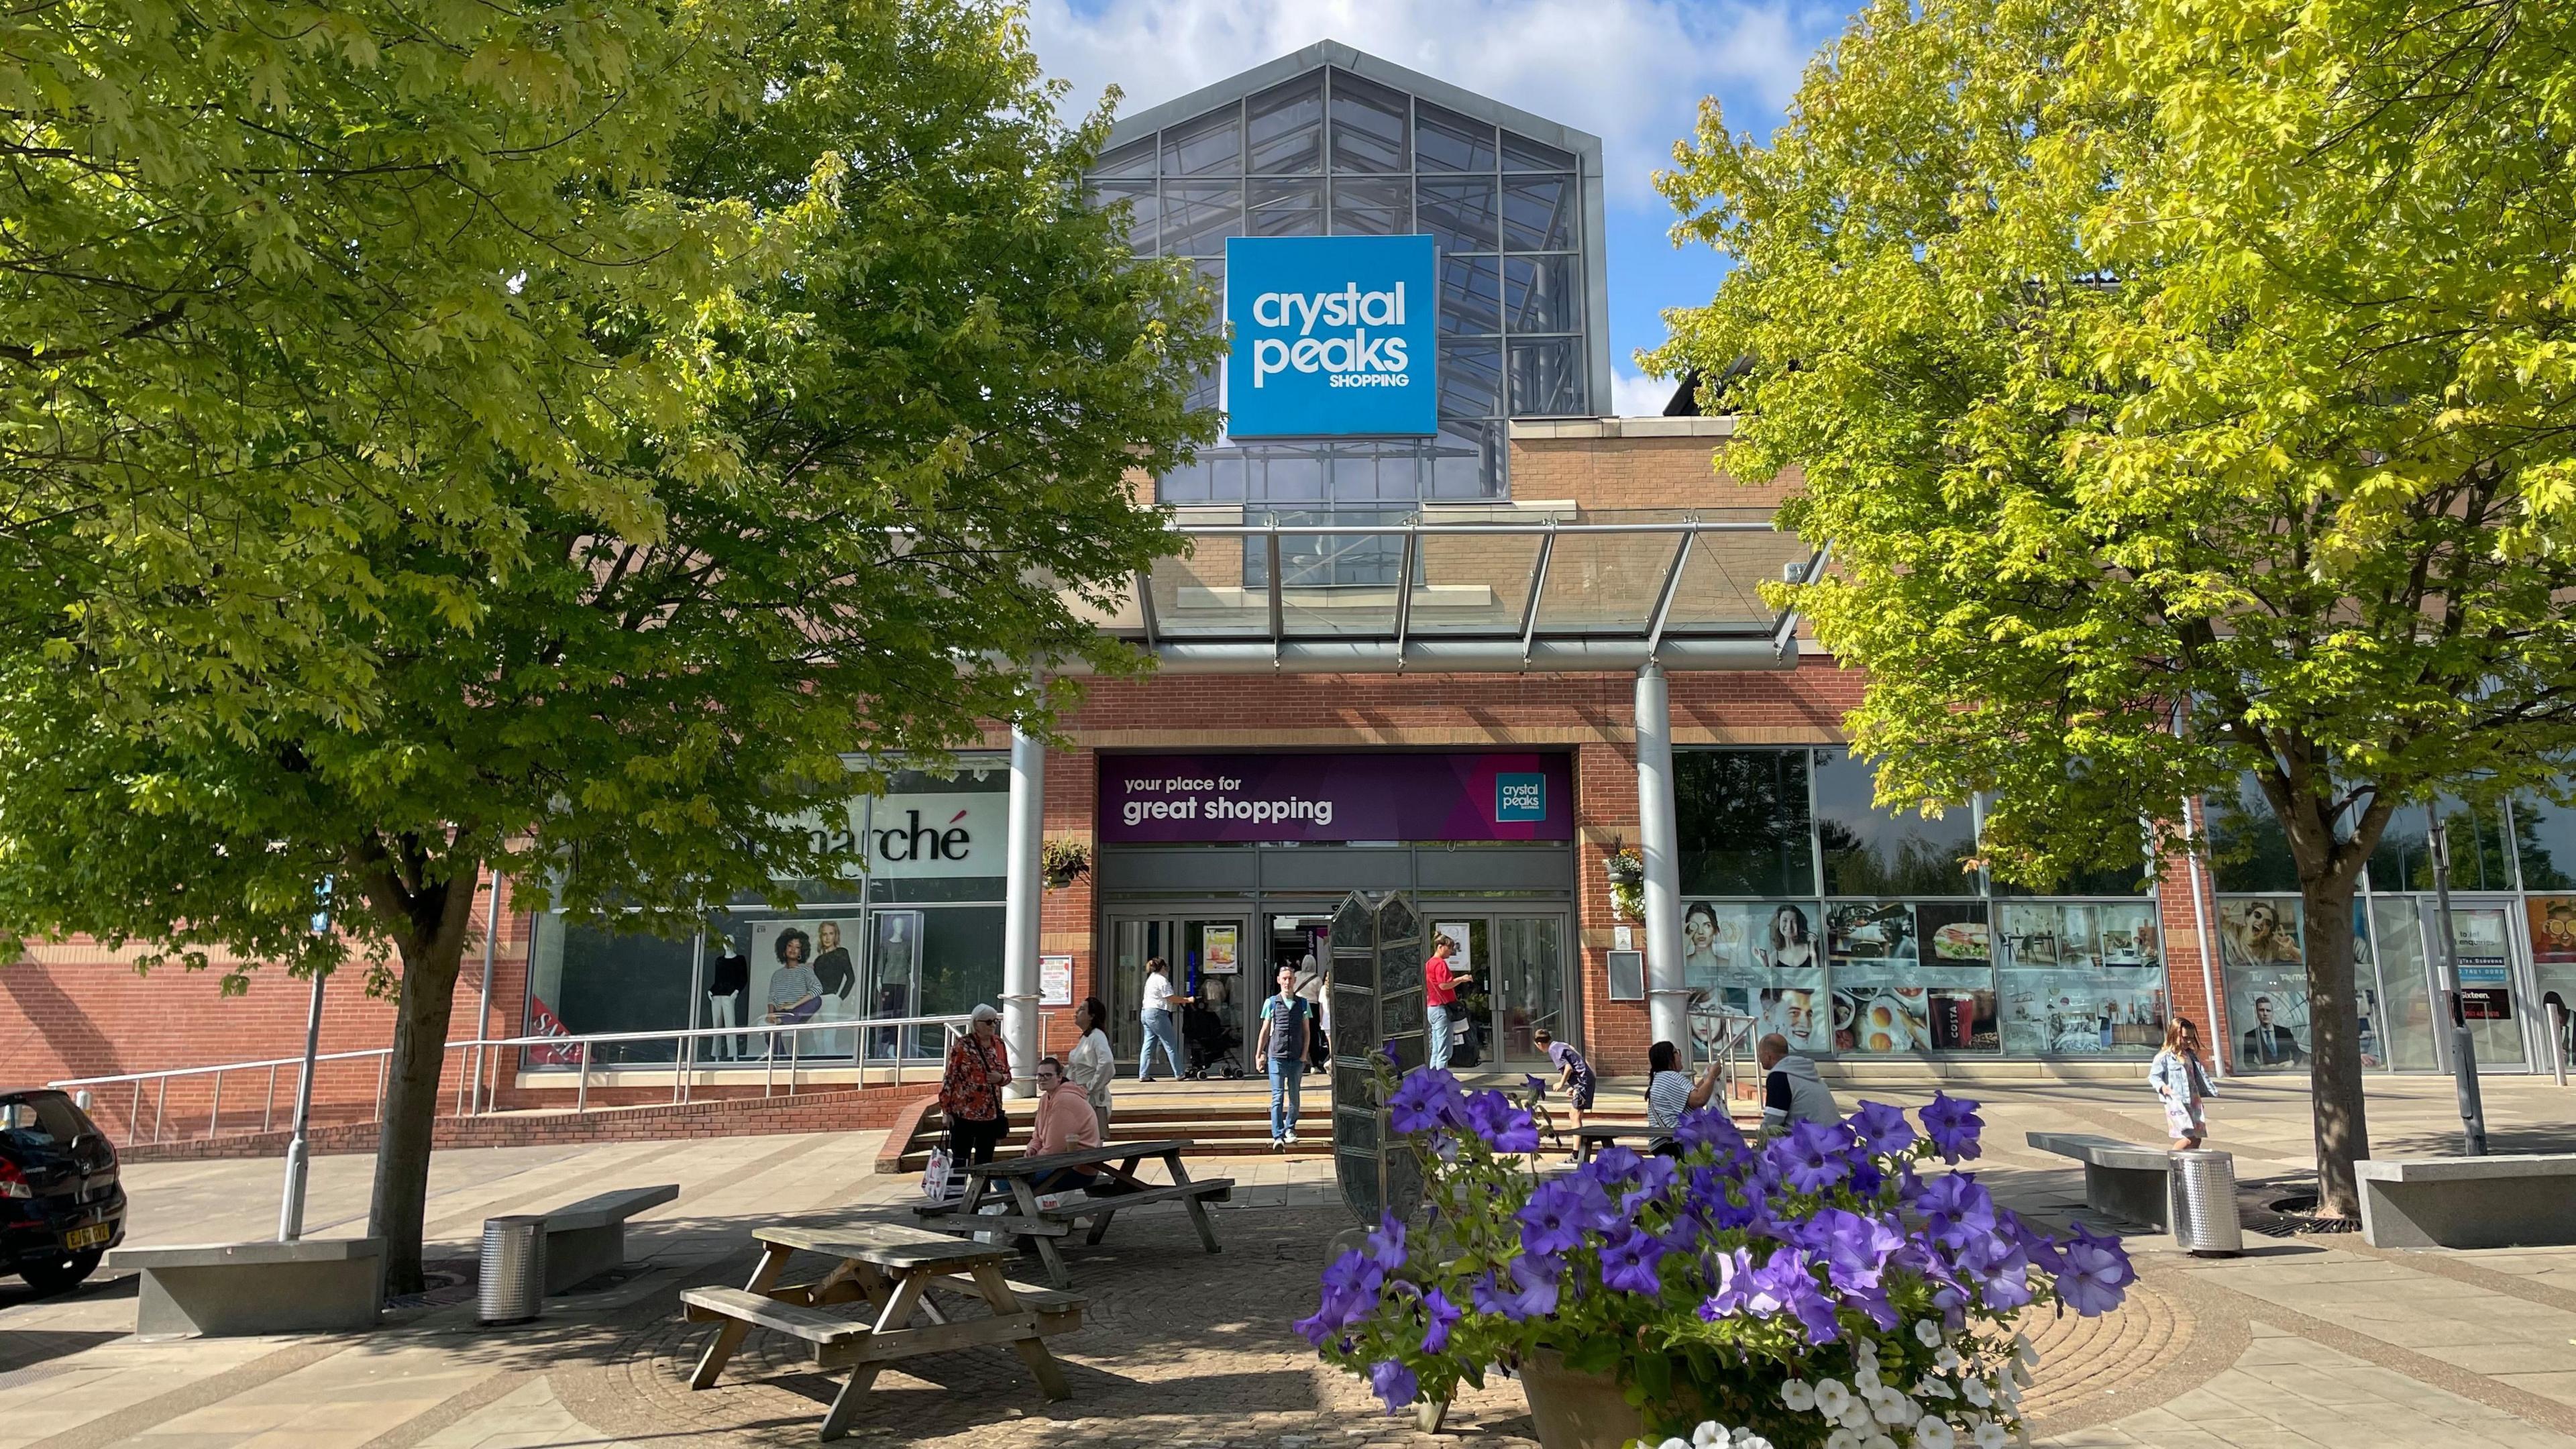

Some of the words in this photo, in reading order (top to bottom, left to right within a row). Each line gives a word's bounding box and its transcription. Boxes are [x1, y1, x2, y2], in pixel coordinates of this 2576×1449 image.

[1252, 281, 1405, 335] crystal
[1253, 328, 1409, 388] peaks
[1329, 373, 1409, 387] SHOPPING
[1124, 779, 1161, 794] your
[1166, 776, 1215, 794] place
[1218, 776, 1241, 790] for
[1503, 783, 1538, 797] crystal
[1123, 796, 1197, 826] great
[1204, 796, 1332, 826] shopping
[1503, 795, 1539, 809] peaks
[1949, 1006, 1959, 1039] COSTA
